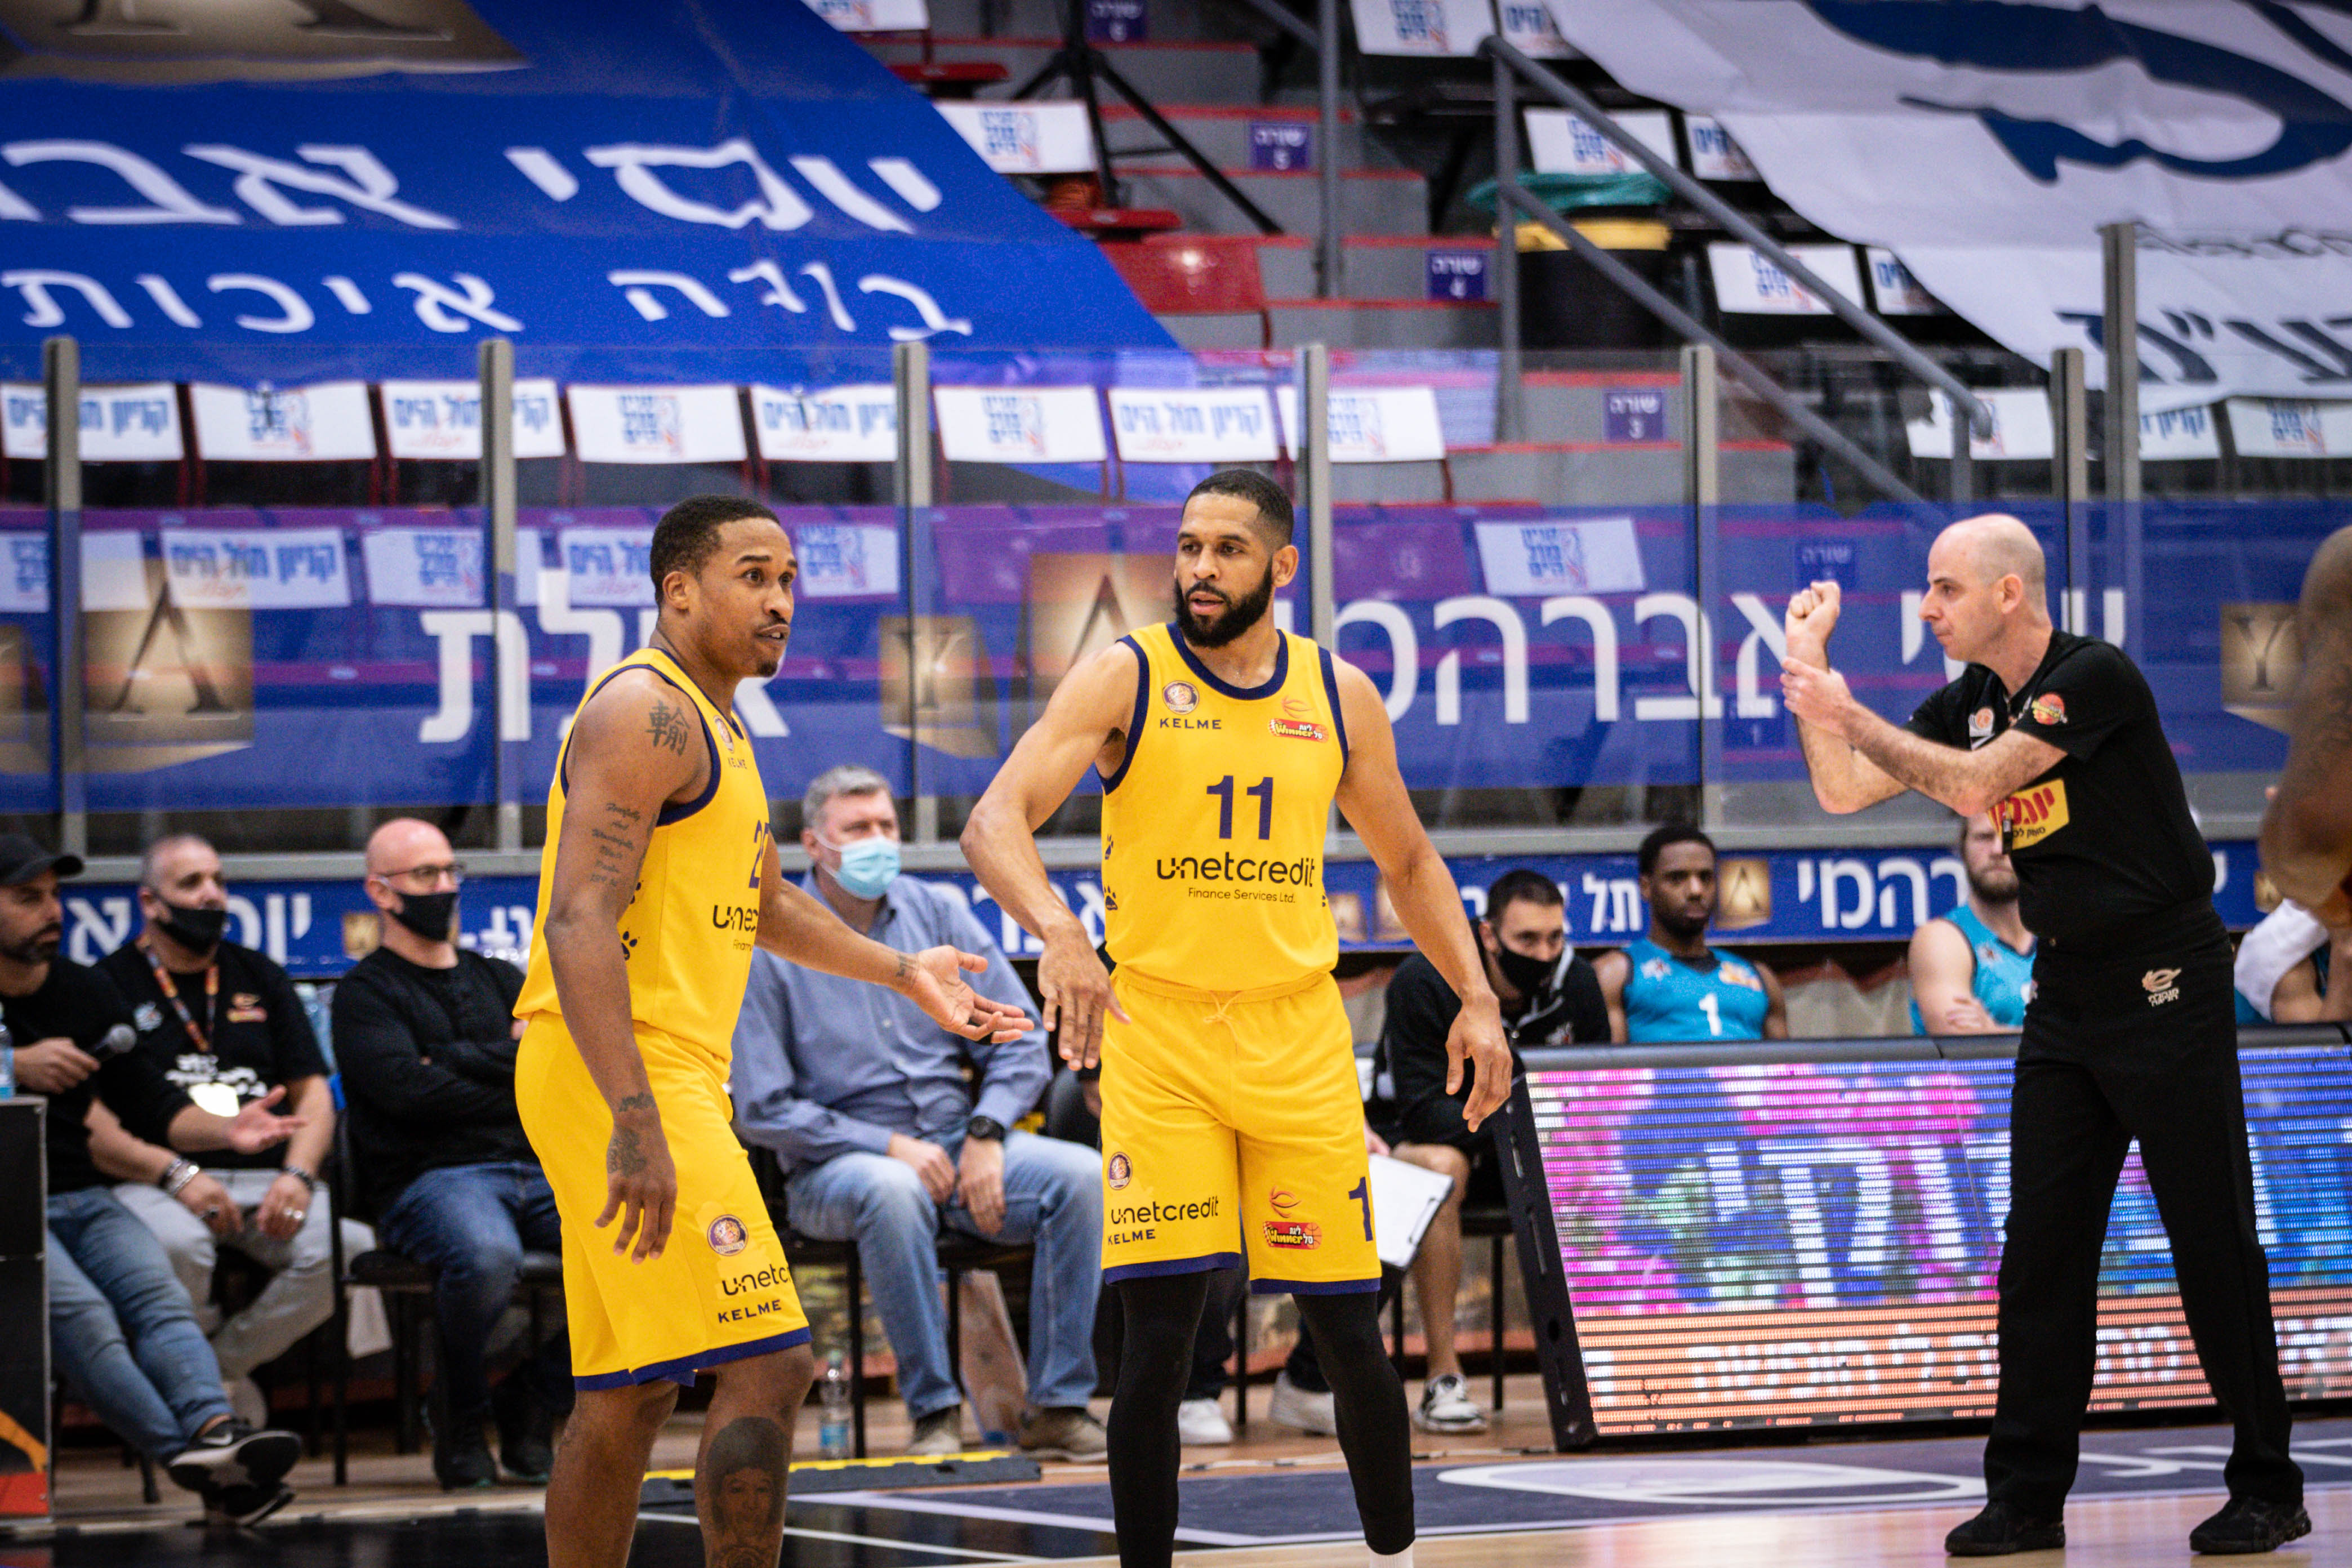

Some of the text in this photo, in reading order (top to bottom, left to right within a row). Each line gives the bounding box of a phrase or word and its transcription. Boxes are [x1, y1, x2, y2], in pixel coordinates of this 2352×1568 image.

[0, 139, 942, 234] יוסי אב
[1, 270, 525, 333] איכות
[1609, 396, 1660, 415] שורה
[1629, 417, 1645, 439] 3
[1160, 718, 1222, 730] KELME
[1275, 723, 1313, 738] Winner
[1206, 775, 1273, 840] 11
[1156, 852, 1315, 888] unetcredit
[1188, 888, 1296, 903] Finance Services Ltd.
[1699, 992, 1721, 1036] 1
[1111, 1196, 1219, 1224] unetcredit
[1107, 1229, 1156, 1245] KELME
[1267, 1228, 1303, 1245] Winner
[718, 1299, 782, 1324] KELME
